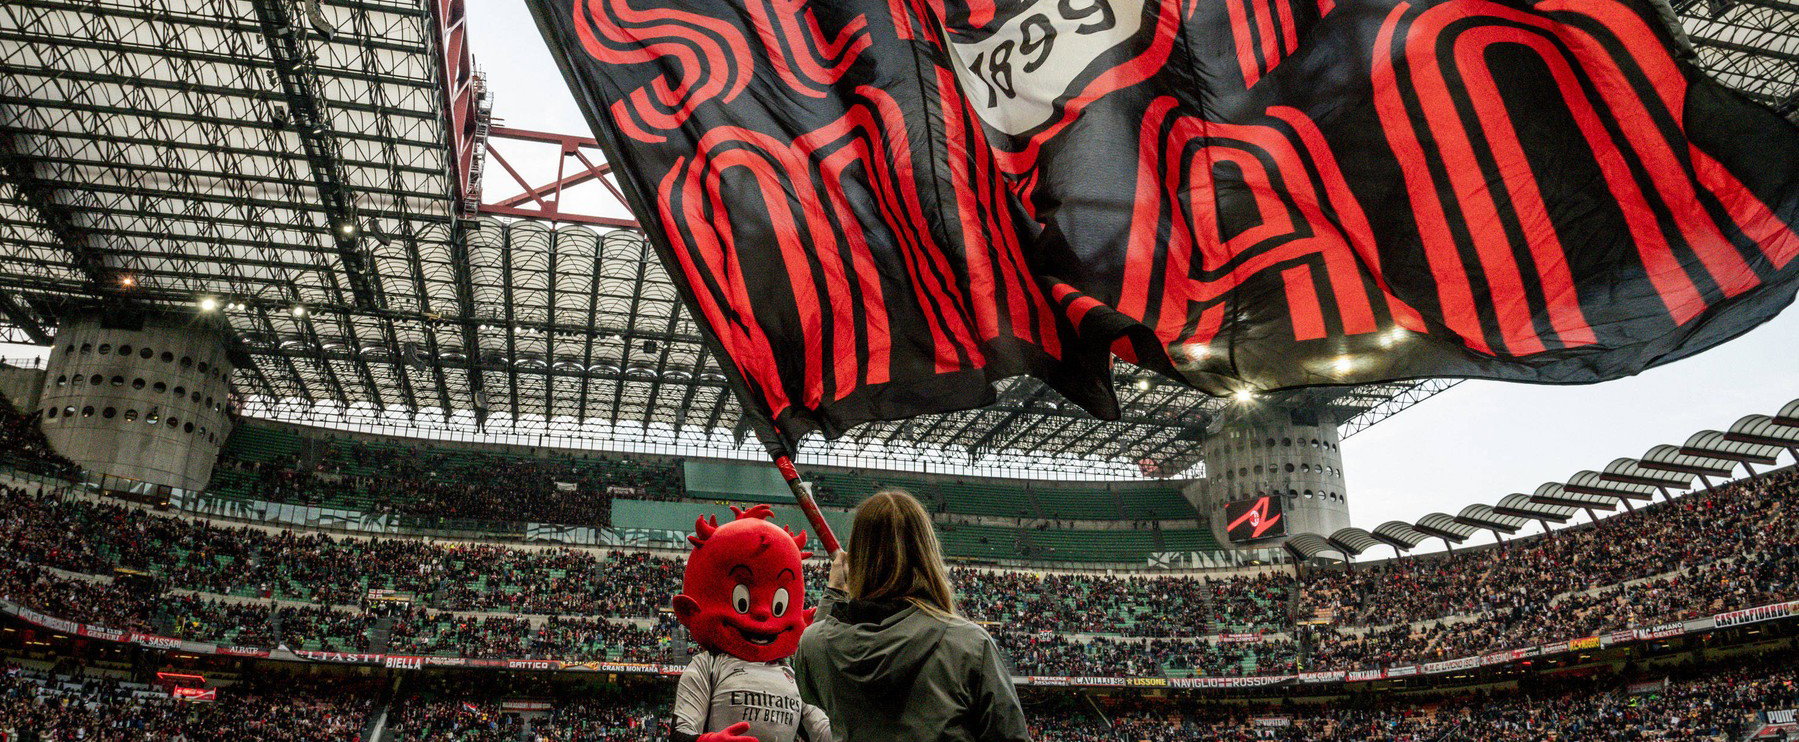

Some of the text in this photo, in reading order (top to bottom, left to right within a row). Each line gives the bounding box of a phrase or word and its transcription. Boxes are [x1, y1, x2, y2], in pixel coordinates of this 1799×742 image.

[968, 0, 1117, 109] 1899
[657, 0, 1799, 420] MIAN
[1714, 603, 1791, 626] CASTELFIDARDO
[1652, 622, 1682, 632] APPIANO
[87, 630, 120, 641] GESTURI
[1653, 629, 1684, 638] GENTILE
[148, 635, 182, 648] SASSARI
[229, 646, 259, 654] ALBATE
[385, 657, 422, 670] BIELLA
[509, 661, 549, 669] GATTICO
[601, 664, 625, 672] CRANS
[625, 665, 659, 673] MONTANA
[1133, 678, 1167, 686] LISSONE
[1173, 677, 1218, 688] NAVIGLIO
[731, 691, 800, 713] Emirates
[743, 707, 795, 727] FLY BETTER
